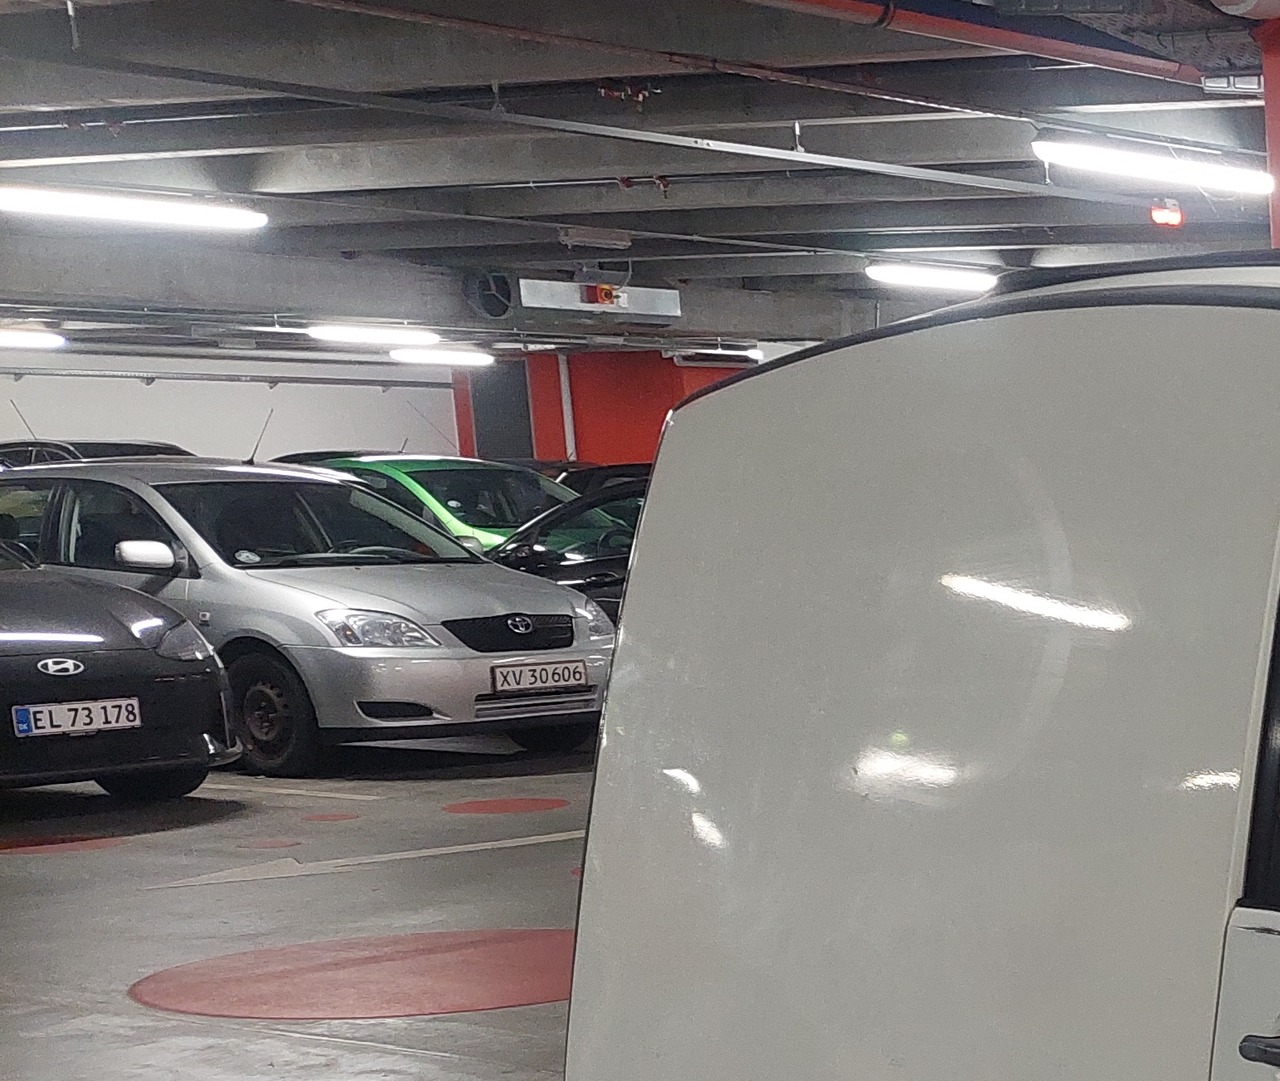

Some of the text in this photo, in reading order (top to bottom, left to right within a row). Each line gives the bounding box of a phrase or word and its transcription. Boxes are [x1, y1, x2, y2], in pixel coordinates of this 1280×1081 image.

[500, 665, 582, 687] XV 30606
[32, 703, 137, 730] EL 73 178
